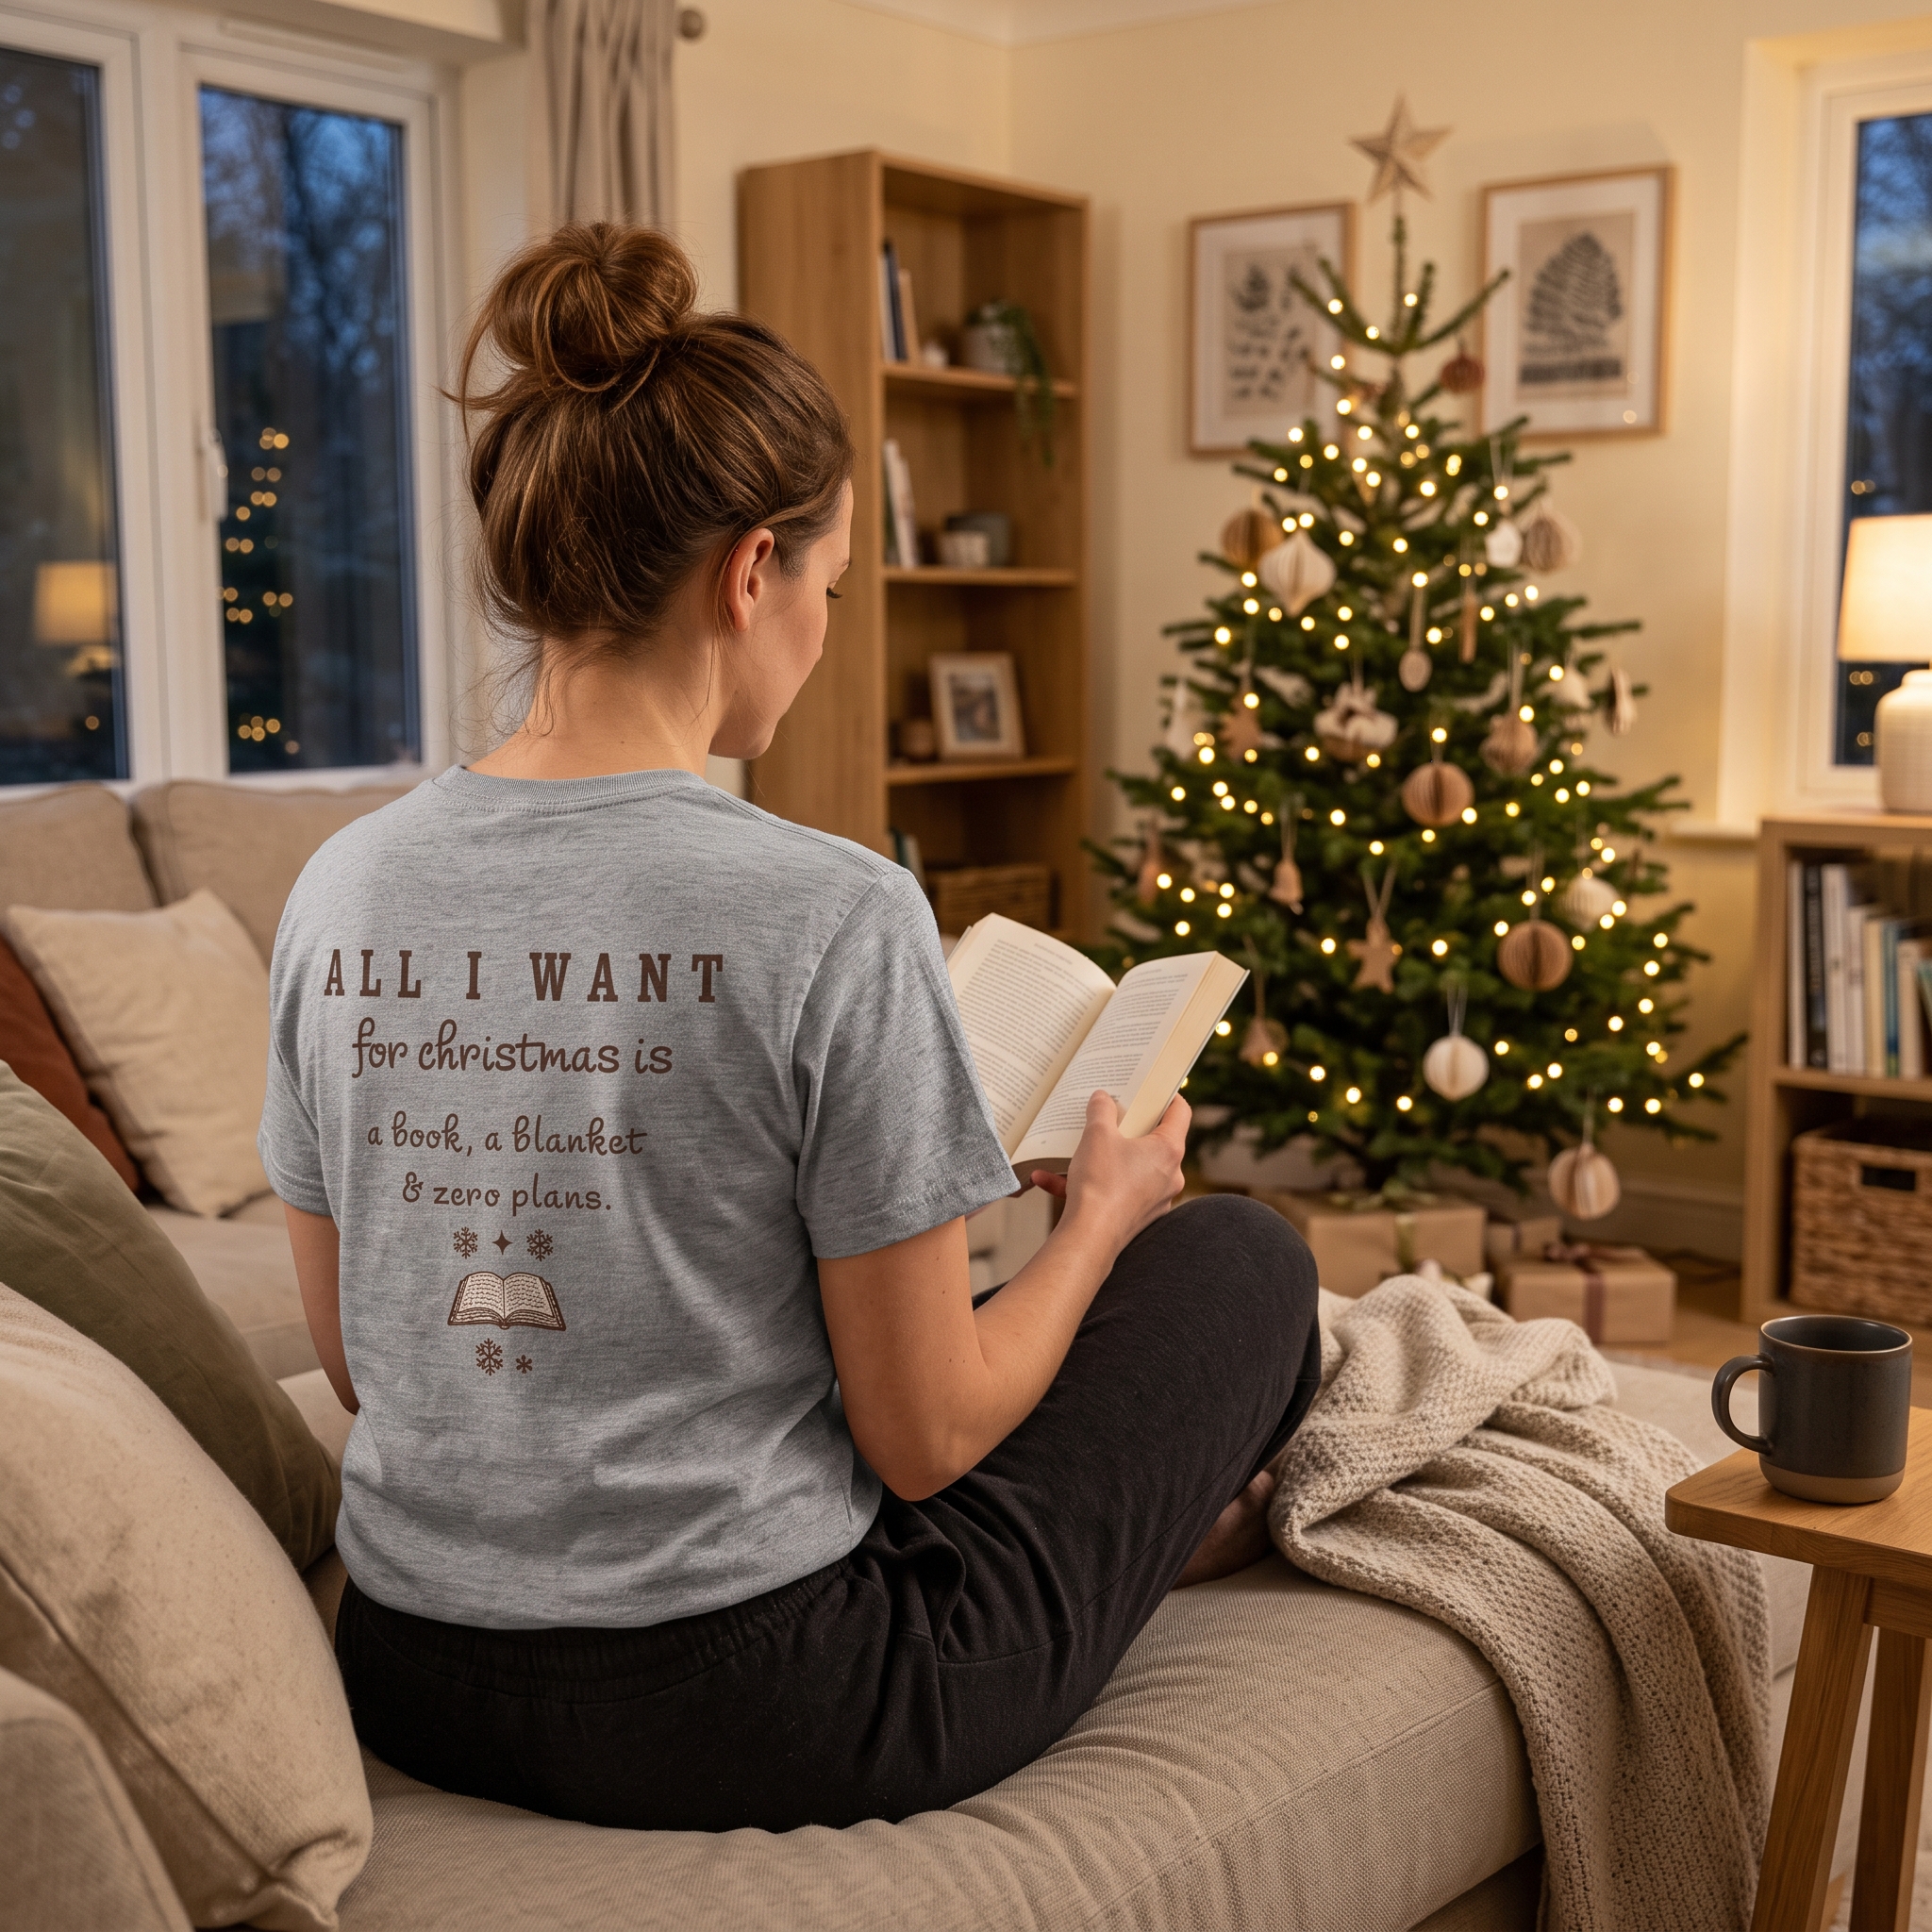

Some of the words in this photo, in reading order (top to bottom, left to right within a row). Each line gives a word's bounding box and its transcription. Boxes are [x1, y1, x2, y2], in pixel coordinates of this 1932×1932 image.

[325, 949, 422, 999] ALL
[466, 951, 482, 1000] I
[529, 952, 724, 1003] WANT
[352, 1017, 408, 1078] for
[418, 1019, 620, 1074] christmas
[634, 1038, 674, 1074] is
[367, 1124, 383, 1146] a
[391, 1110, 474, 1157] book,
[485, 1130, 502, 1152] a
[512, 1114, 647, 1156] blanket
[402, 1172, 424, 1203] &
[433, 1186, 501, 1207] zero
[512, 1173, 611, 1217] plans.
